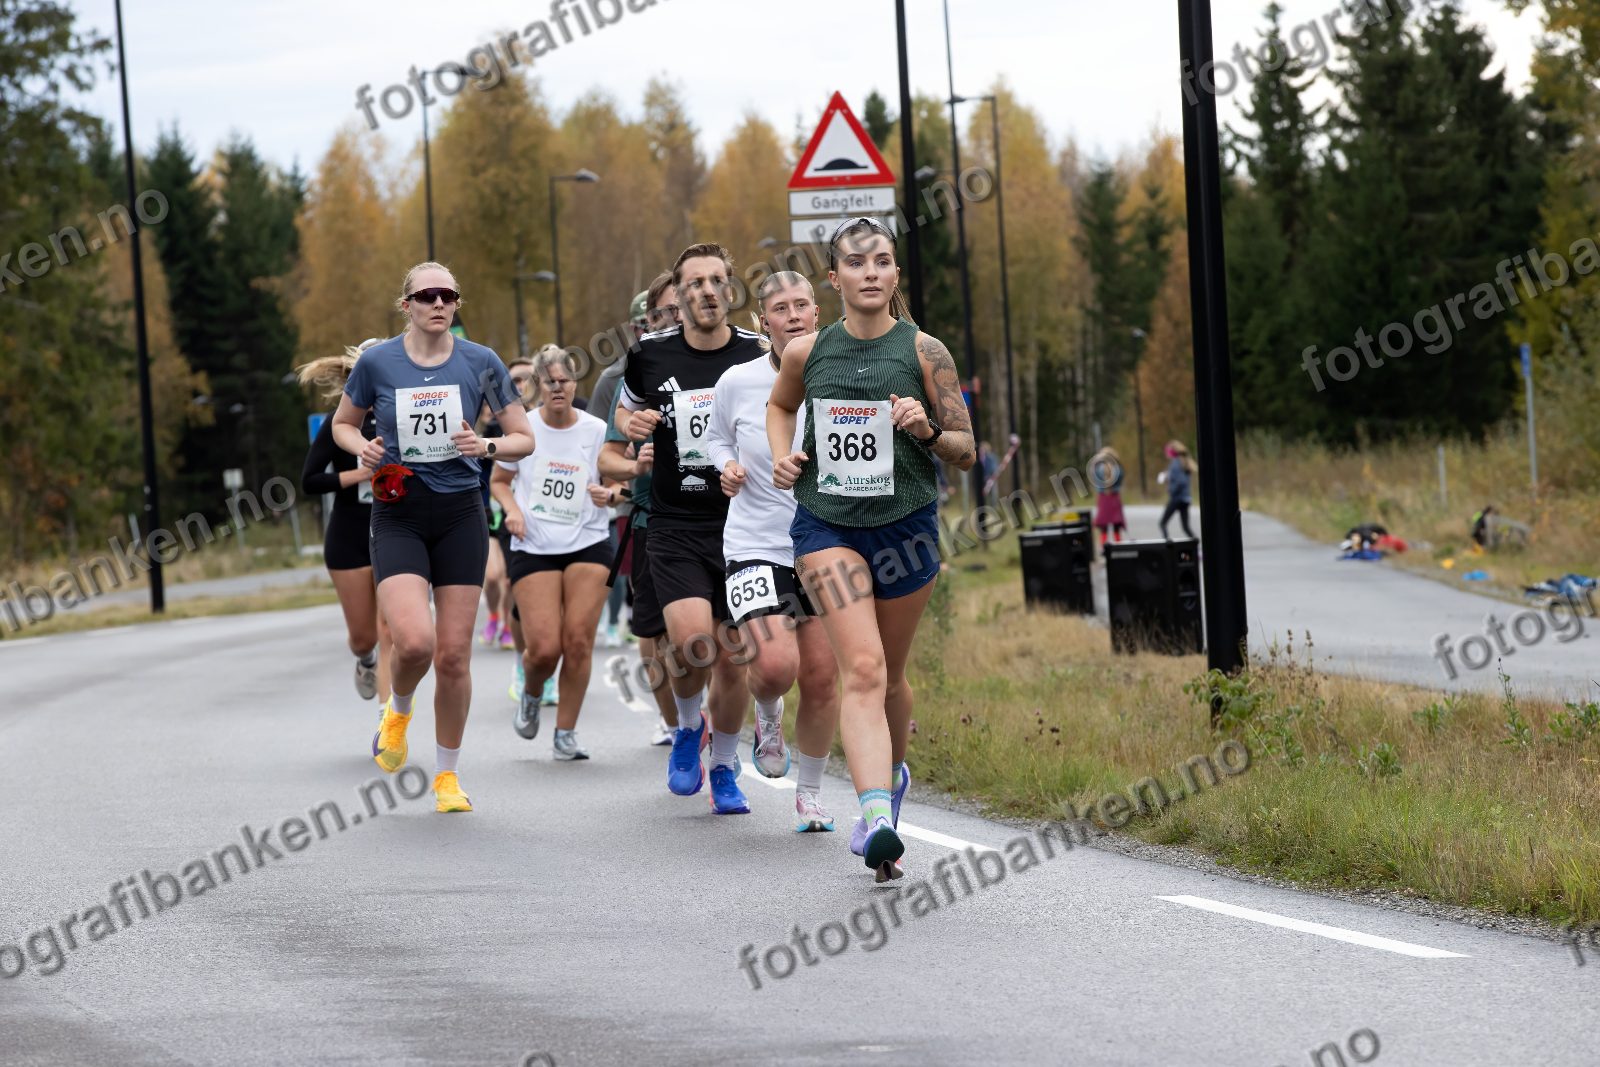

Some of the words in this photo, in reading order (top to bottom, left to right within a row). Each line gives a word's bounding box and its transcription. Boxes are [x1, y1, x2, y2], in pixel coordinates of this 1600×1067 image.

[811, 195, 874, 210] Gangfelt
[411, 391, 449, 400] NORGES
[414, 399, 443, 407] LØPET
[830, 407, 878, 416] NORGES
[409, 412, 448, 435] 731
[833, 415, 870, 424] LØPET
[427, 444, 457, 453] Aursko
[828, 432, 877, 461] 368
[548, 461, 580, 472] NORGES
[845, 474, 891, 486] Aurskog
[541, 478, 575, 500] 509
[730, 577, 770, 608] 653
